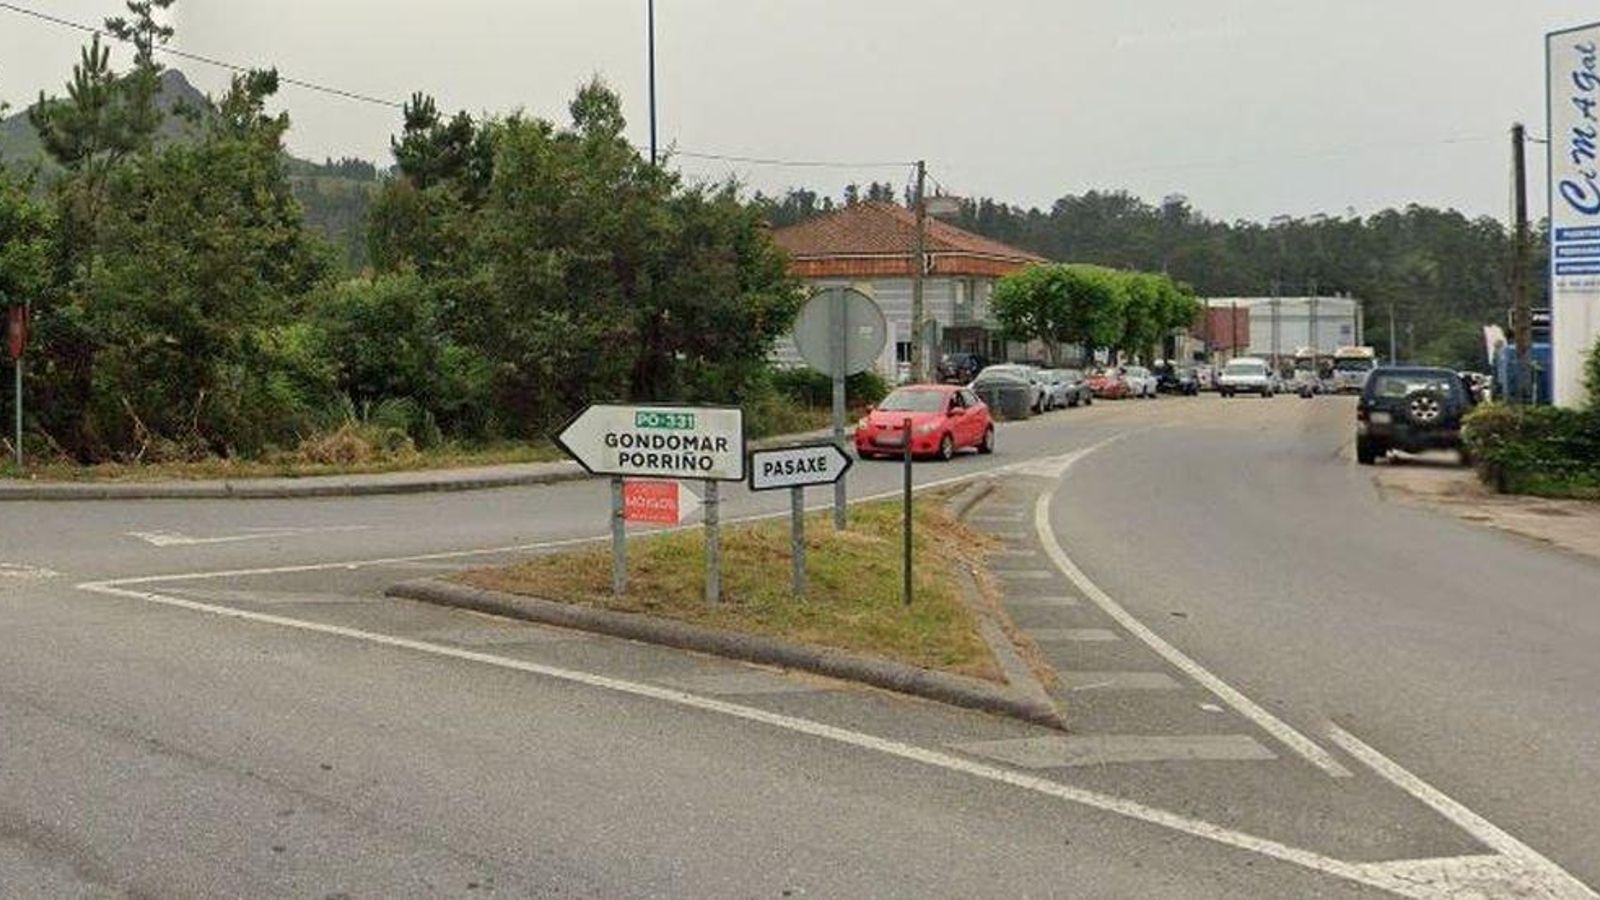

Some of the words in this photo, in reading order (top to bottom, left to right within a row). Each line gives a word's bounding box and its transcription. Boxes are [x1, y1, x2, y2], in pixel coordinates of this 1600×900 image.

[637, 413, 694, 429] PO-331
[604, 432, 728, 452] GONDOMAR
[619, 451, 713, 471] PORRIÑO
[763, 456, 827, 477] PASAXE
